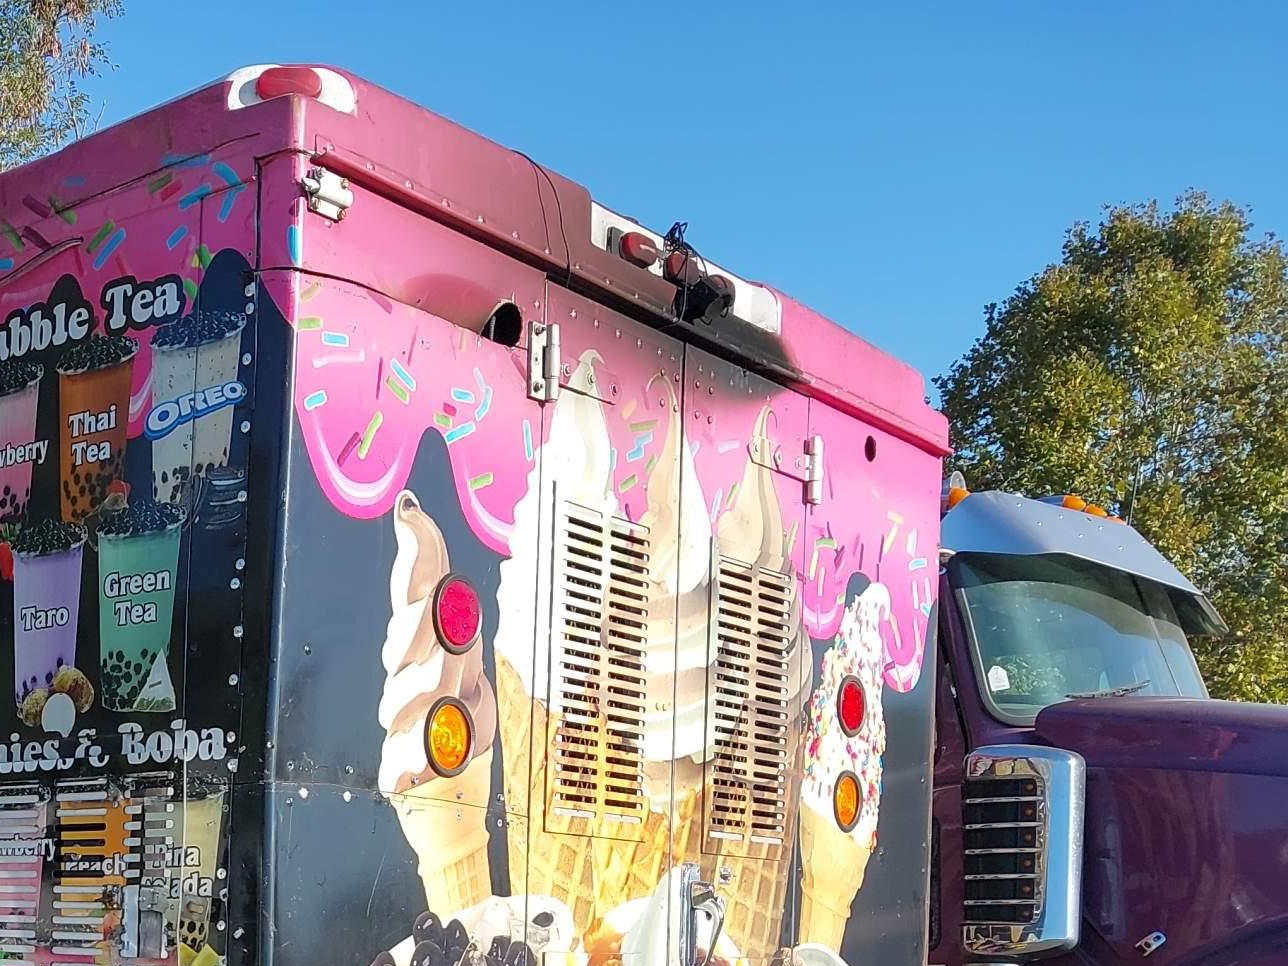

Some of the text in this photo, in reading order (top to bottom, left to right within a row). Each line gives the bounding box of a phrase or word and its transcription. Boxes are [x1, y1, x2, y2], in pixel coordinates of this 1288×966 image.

[106, 281, 180, 330] Tea
[147, 381, 244, 431] OREO
[69, 405, 116, 438] Thai
[71, 441, 111, 466] Tea
[104, 570, 170, 598] Green
[21, 606, 69, 631] Taro
[115, 602, 157, 626] Tea
[76, 729, 109, 767] &
[119, 719, 227, 764] Boba
